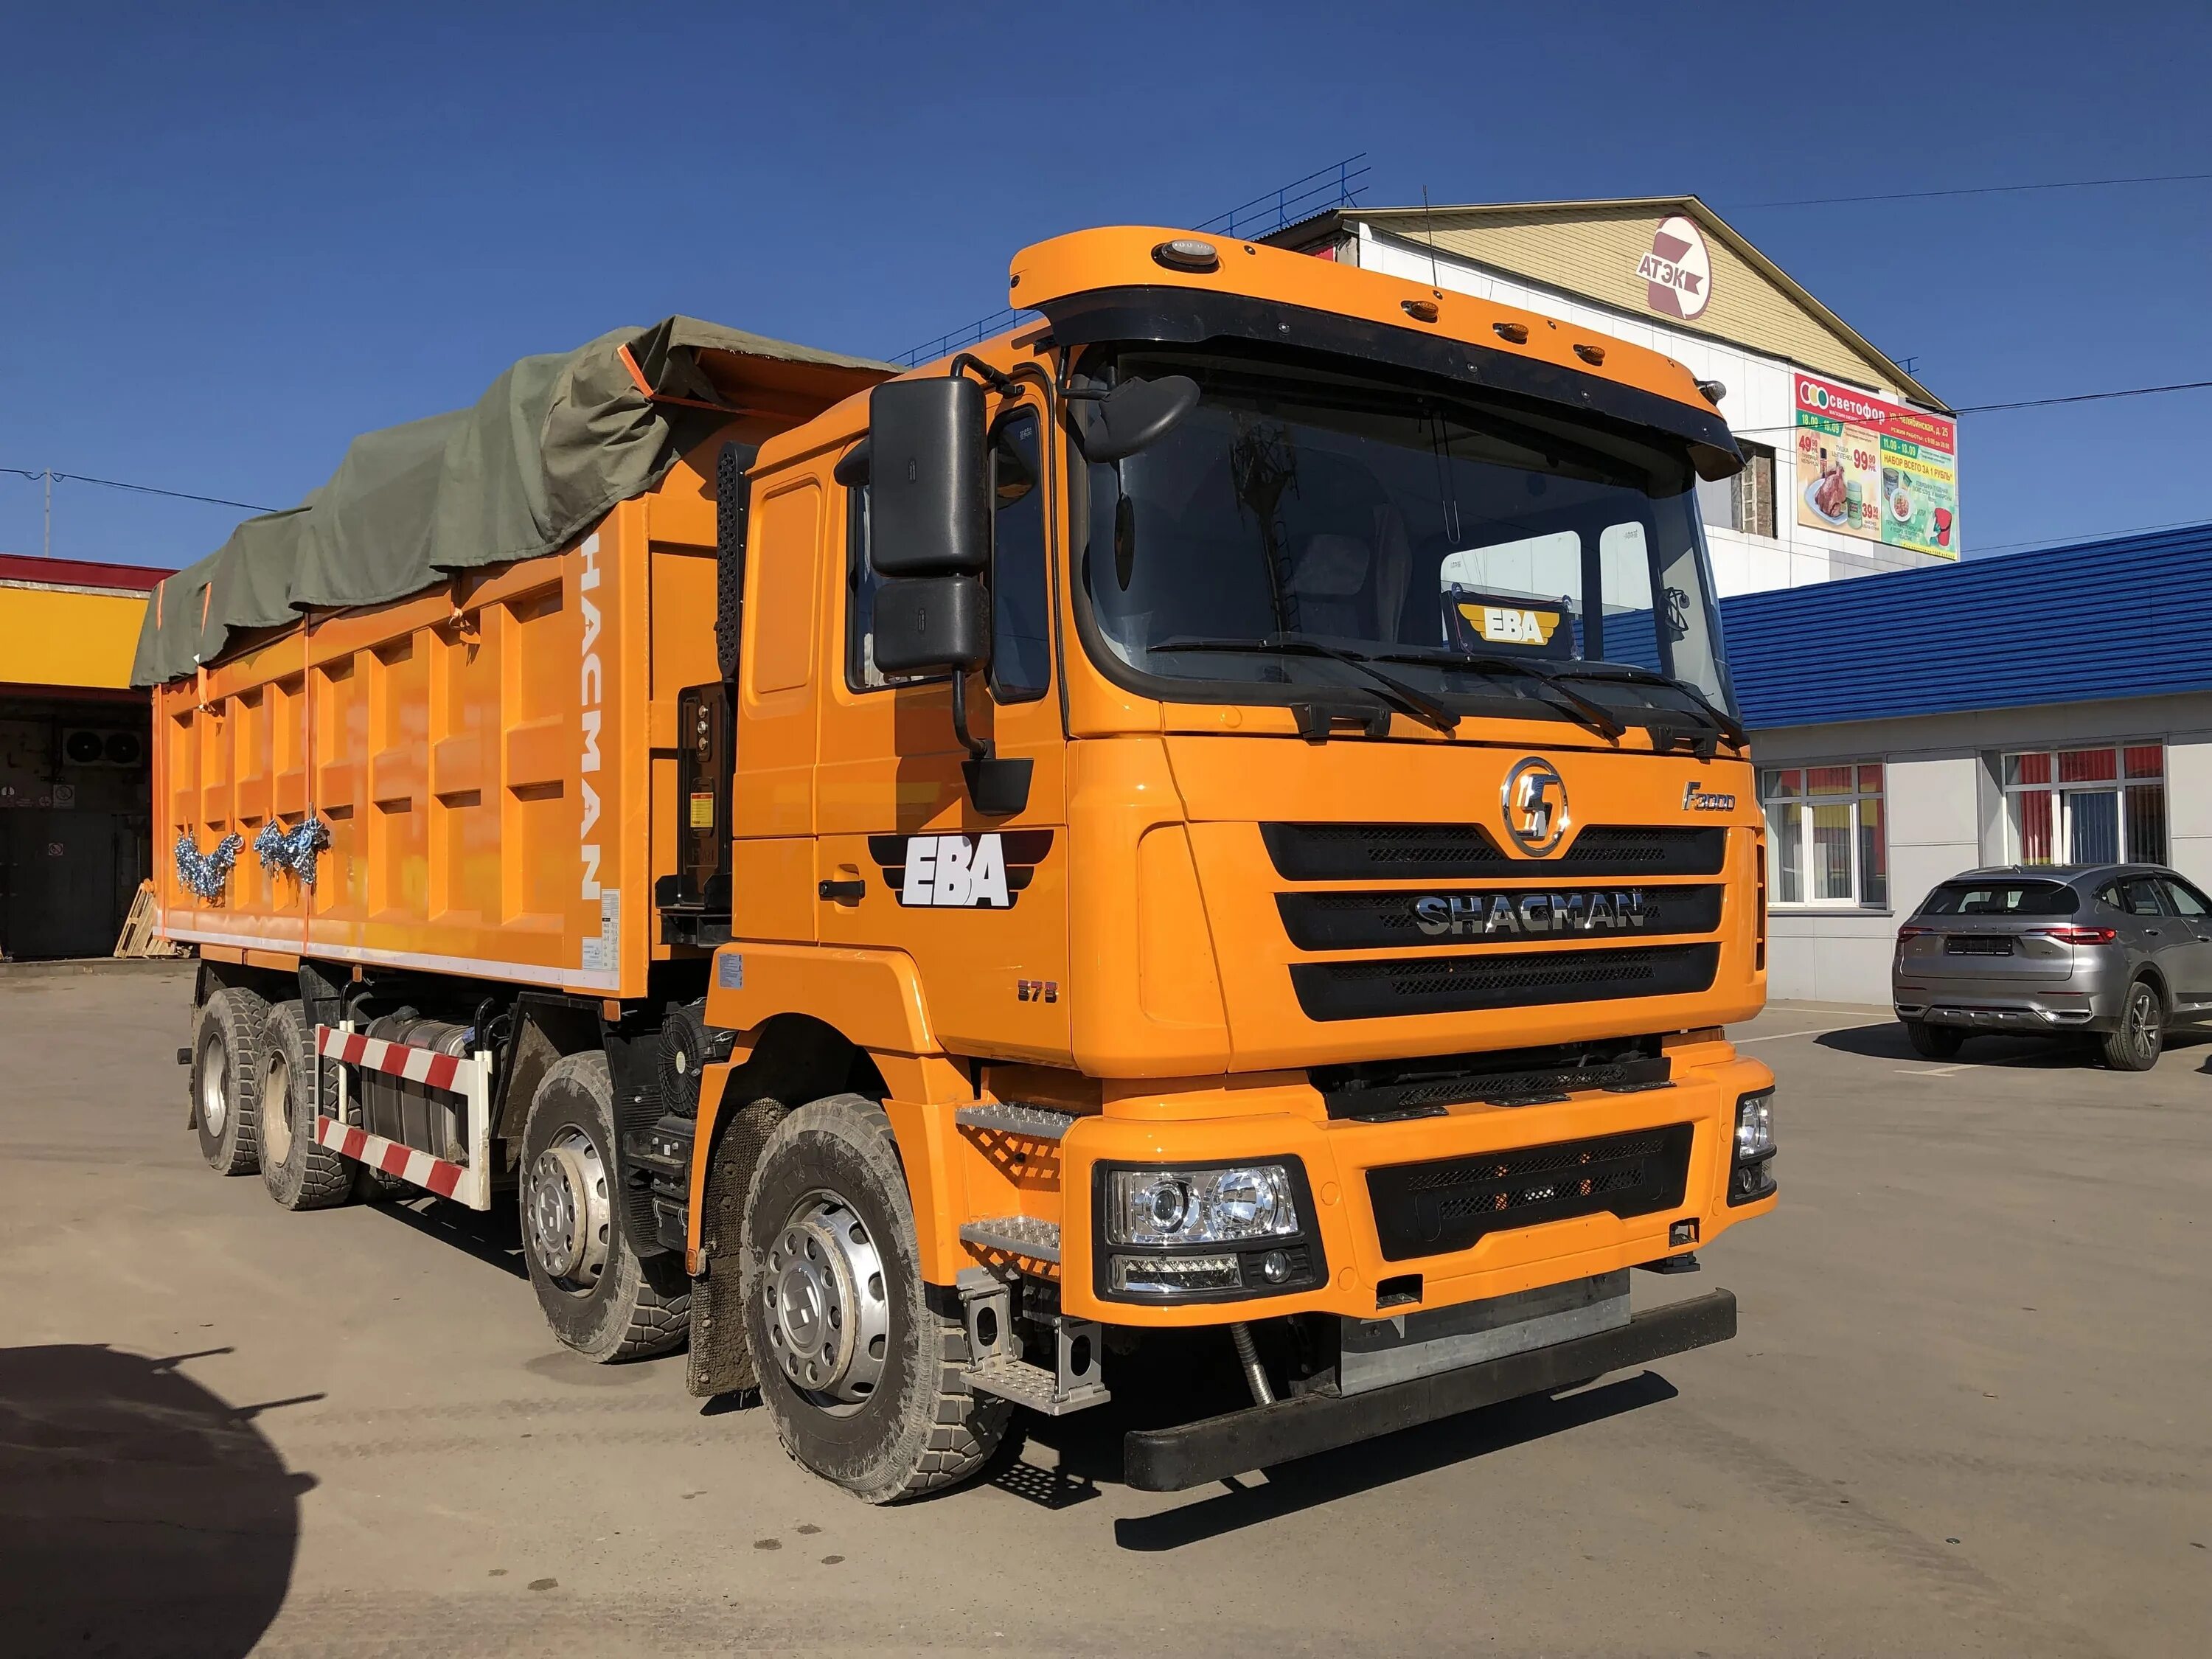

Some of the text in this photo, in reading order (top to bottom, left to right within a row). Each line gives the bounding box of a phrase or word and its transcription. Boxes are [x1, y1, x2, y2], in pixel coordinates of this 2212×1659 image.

[1638, 256, 1686, 289] АТЭК
[1829, 394, 1885, 425] светофор
[1941, 426, 1949, 437] 25
[1799, 435, 1811, 452] 49
[1883, 438, 1897, 451] 11.09
[1902, 443, 1916, 456] 13.09
[1854, 449, 1876, 470] 99 90
[1884, 453, 1903, 467] НАБОР
[1904, 459, 1921, 472] ВСЕГО
[1922, 465, 1930, 475] ЗА
[1862, 503, 1873, 519] 39
[1414, 893, 1644, 936] SHACMAN
